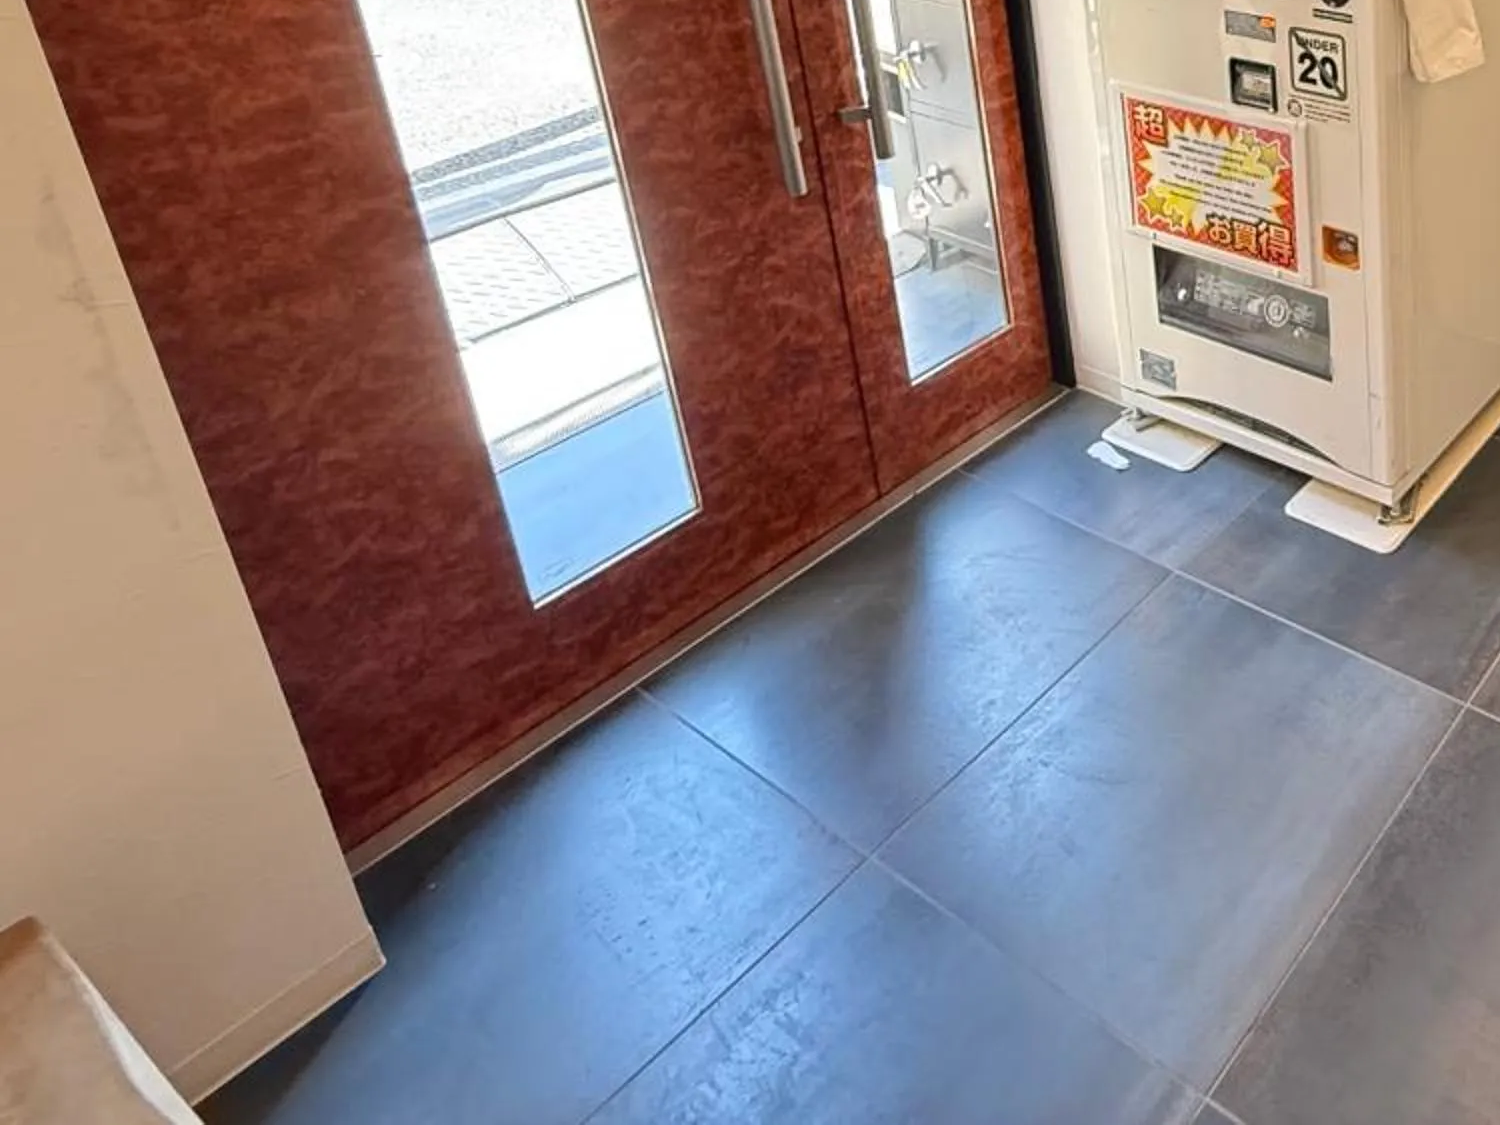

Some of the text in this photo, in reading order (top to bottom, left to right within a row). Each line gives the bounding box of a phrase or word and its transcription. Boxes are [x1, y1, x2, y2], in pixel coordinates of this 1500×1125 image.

[1298, 52, 1338, 89] 20
[1207, 216, 1295, 266] お買得
